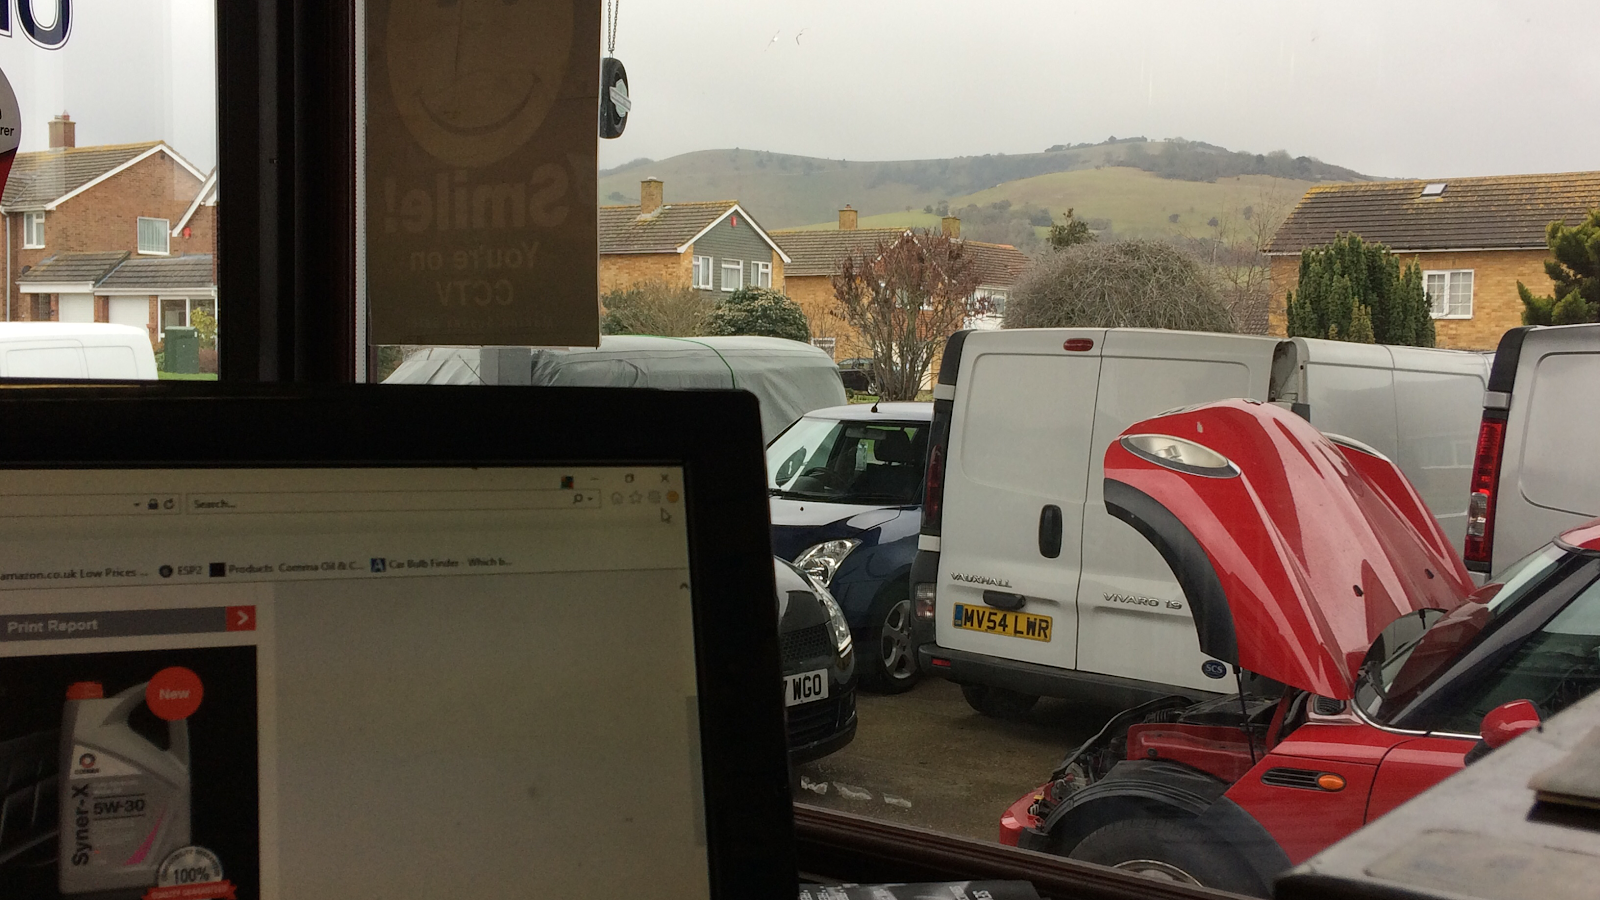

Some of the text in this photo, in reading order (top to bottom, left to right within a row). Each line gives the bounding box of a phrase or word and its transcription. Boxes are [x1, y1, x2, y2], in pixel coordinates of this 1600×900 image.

[229, 563, 273, 573] Products
[279, 563, 318, 572] Comma
[321, 561, 336, 571] Oil
[389, 559, 405, 569] Car
[407, 558, 428, 568] Bulb
[430, 558, 459, 568] Finder
[468, 557, 497, 567] Which
[80, 569, 102, 578] Low
[105, 568, 137, 577] Prices
[950, 572, 1012, 588] VAUXHALL
[1103, 592, 1159, 607] VIVARO
[7, 619, 99, 634] Print Report
[964, 608, 1050, 639] MV54 LWR
[1206, 664, 1223, 674] SCS
[159, 688, 191, 700] New
[793, 674, 821, 700] WGO
[94, 799, 146, 816] 5W-30
[71, 784, 92, 866] Syner-X
[174, 866, 210, 884] 100%
